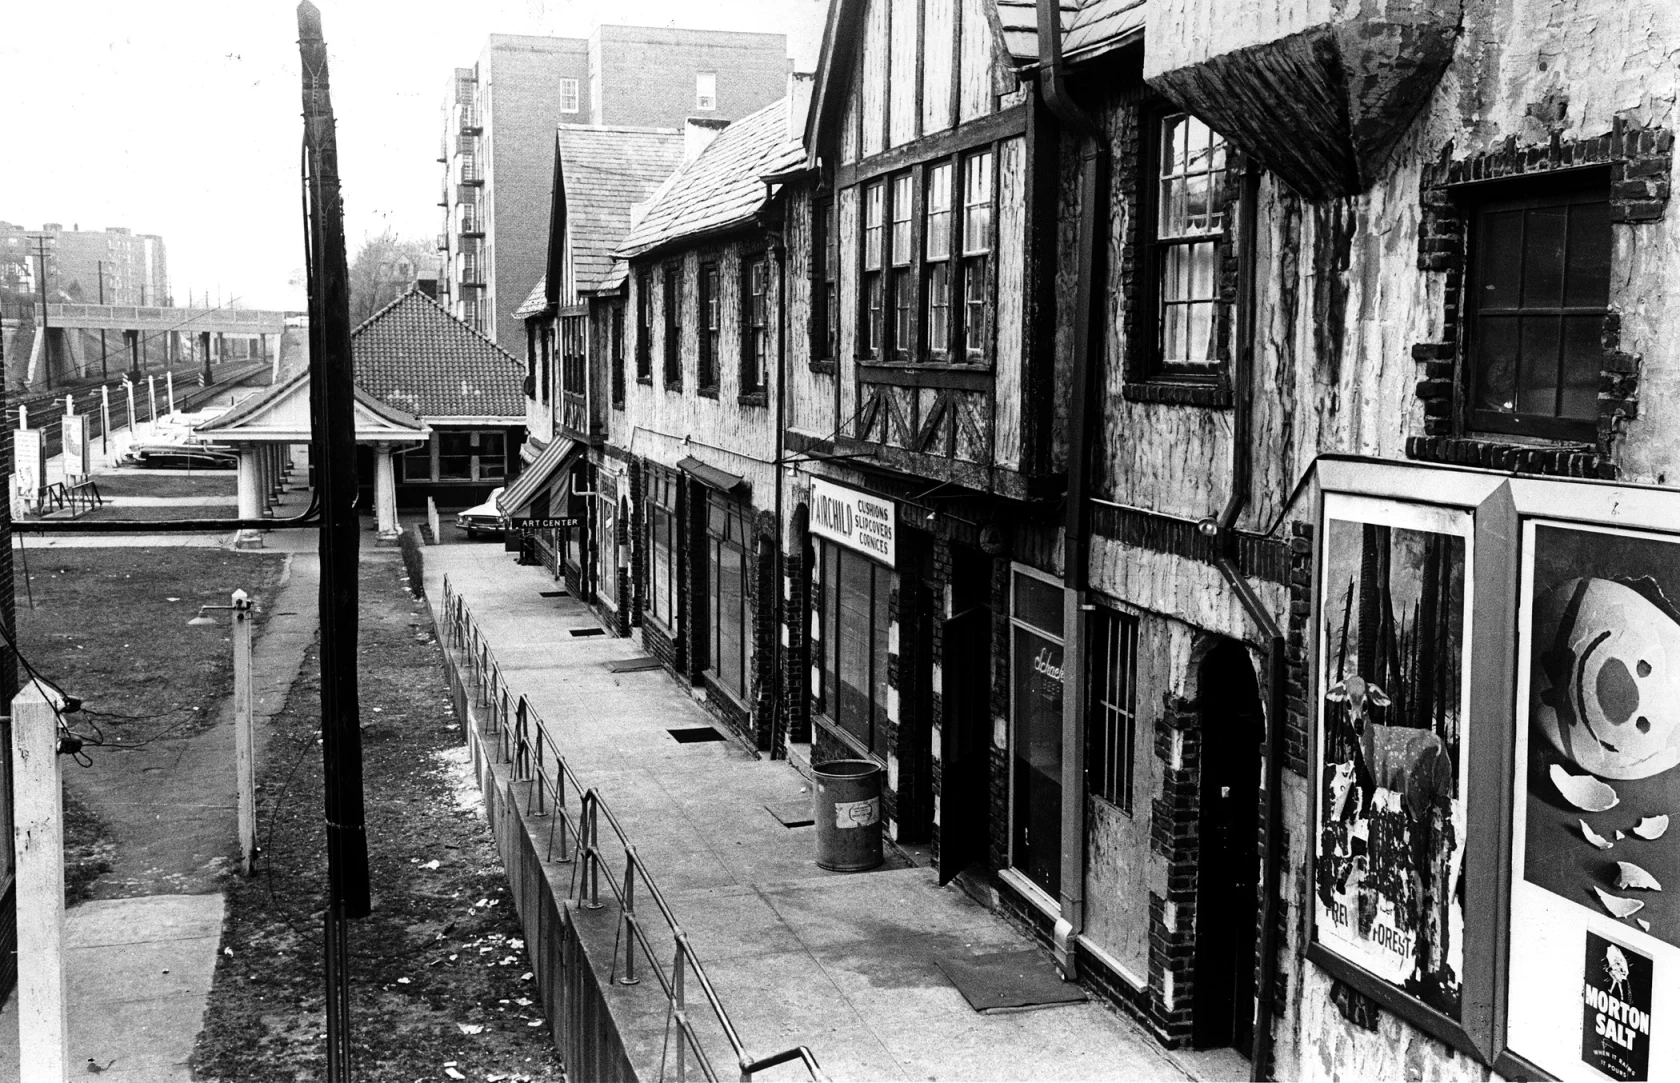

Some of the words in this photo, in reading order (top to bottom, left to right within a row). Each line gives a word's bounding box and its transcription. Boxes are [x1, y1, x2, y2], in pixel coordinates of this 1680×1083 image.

[811, 483, 853, 537] FAIRCHILD
[857, 499, 888, 521] CUSHIONS
[521, 519, 540, 527] ART
[542, 518, 578, 527] CENTER
[854, 514, 892, 540] SLIPCOVERS
[859, 531, 888, 555] CORNICES
[1585, 983, 1650, 1036] MORTON
[1595, 1012, 1636, 1051] SALT
[1593, 1049, 1610, 1057] WHEN
[1607, 1063, 1627, 1078] POURS
